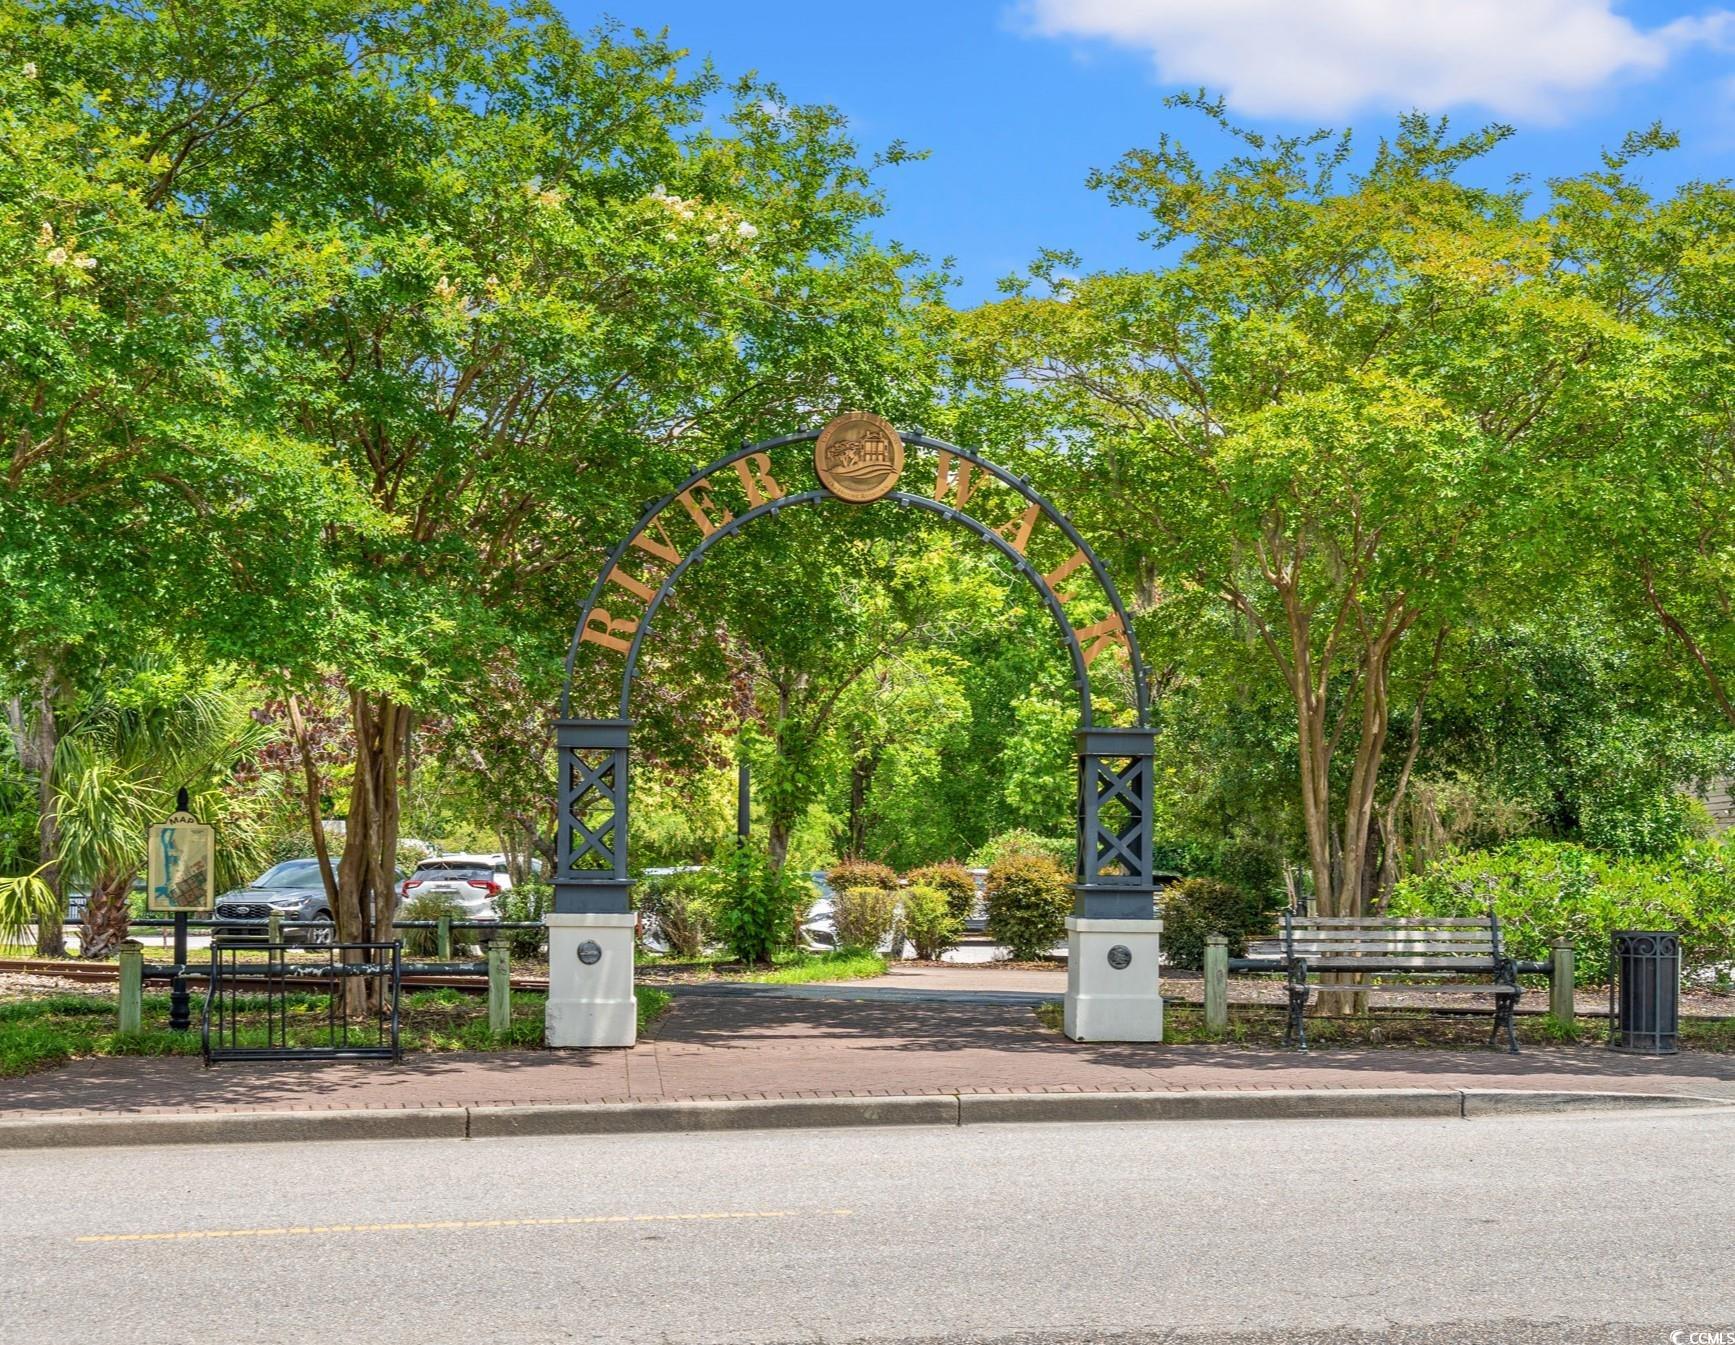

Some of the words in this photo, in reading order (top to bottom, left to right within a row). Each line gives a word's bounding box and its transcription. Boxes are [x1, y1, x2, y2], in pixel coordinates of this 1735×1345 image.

[579, 452, 786, 655] RIVER
[934, 449, 1133, 668] WALK
[169, 816, 195, 825] MAP
